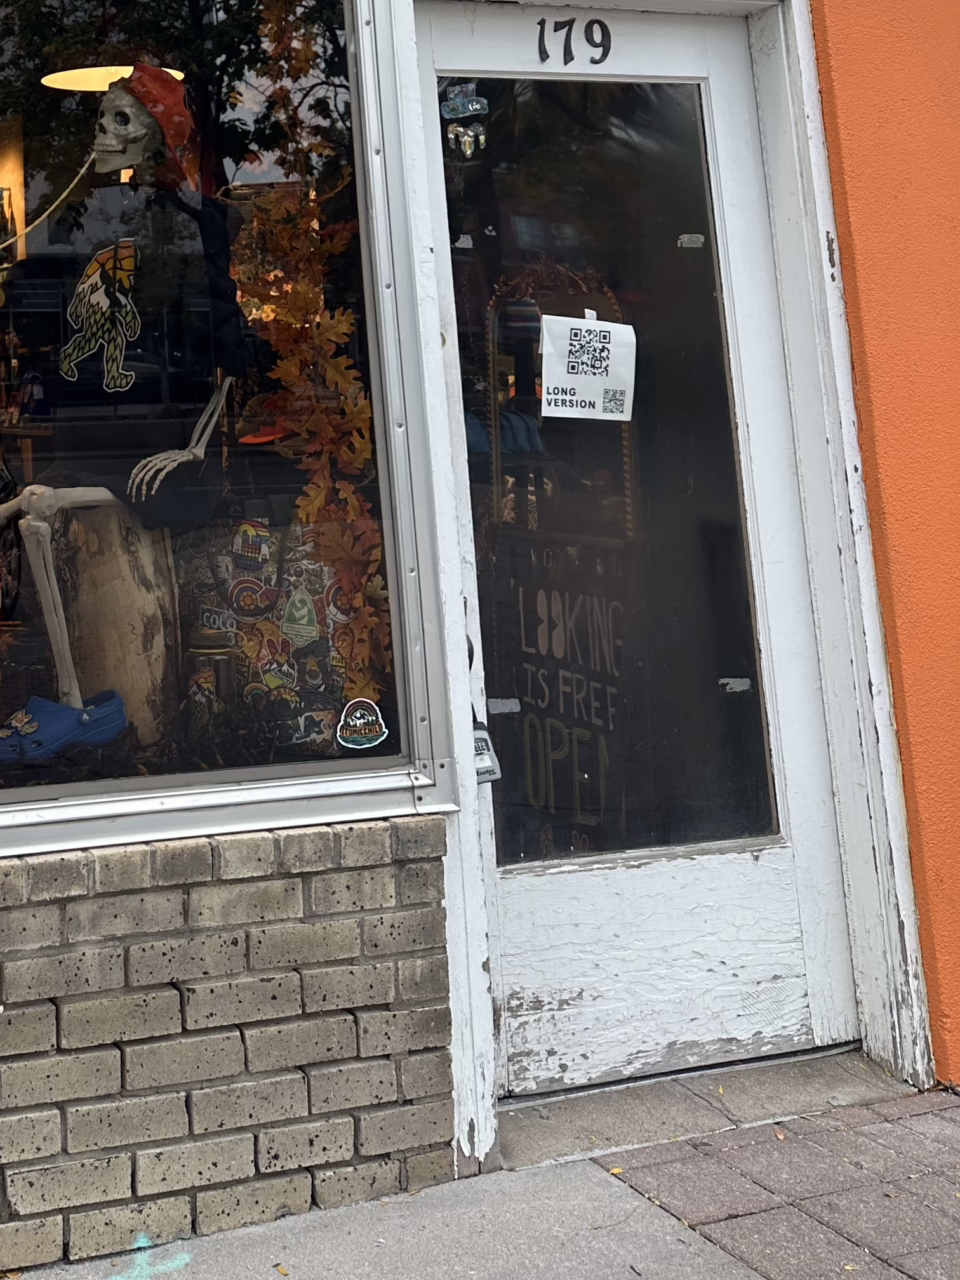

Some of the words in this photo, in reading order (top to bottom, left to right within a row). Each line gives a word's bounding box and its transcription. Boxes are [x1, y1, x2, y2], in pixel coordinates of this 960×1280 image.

[537, 17, 612, 66] 179
[546, 386, 577, 397] LONG
[546, 397, 596, 410] VERSION
[522, 662, 549, 709] IS
[558, 668, 618, 731] FREE
